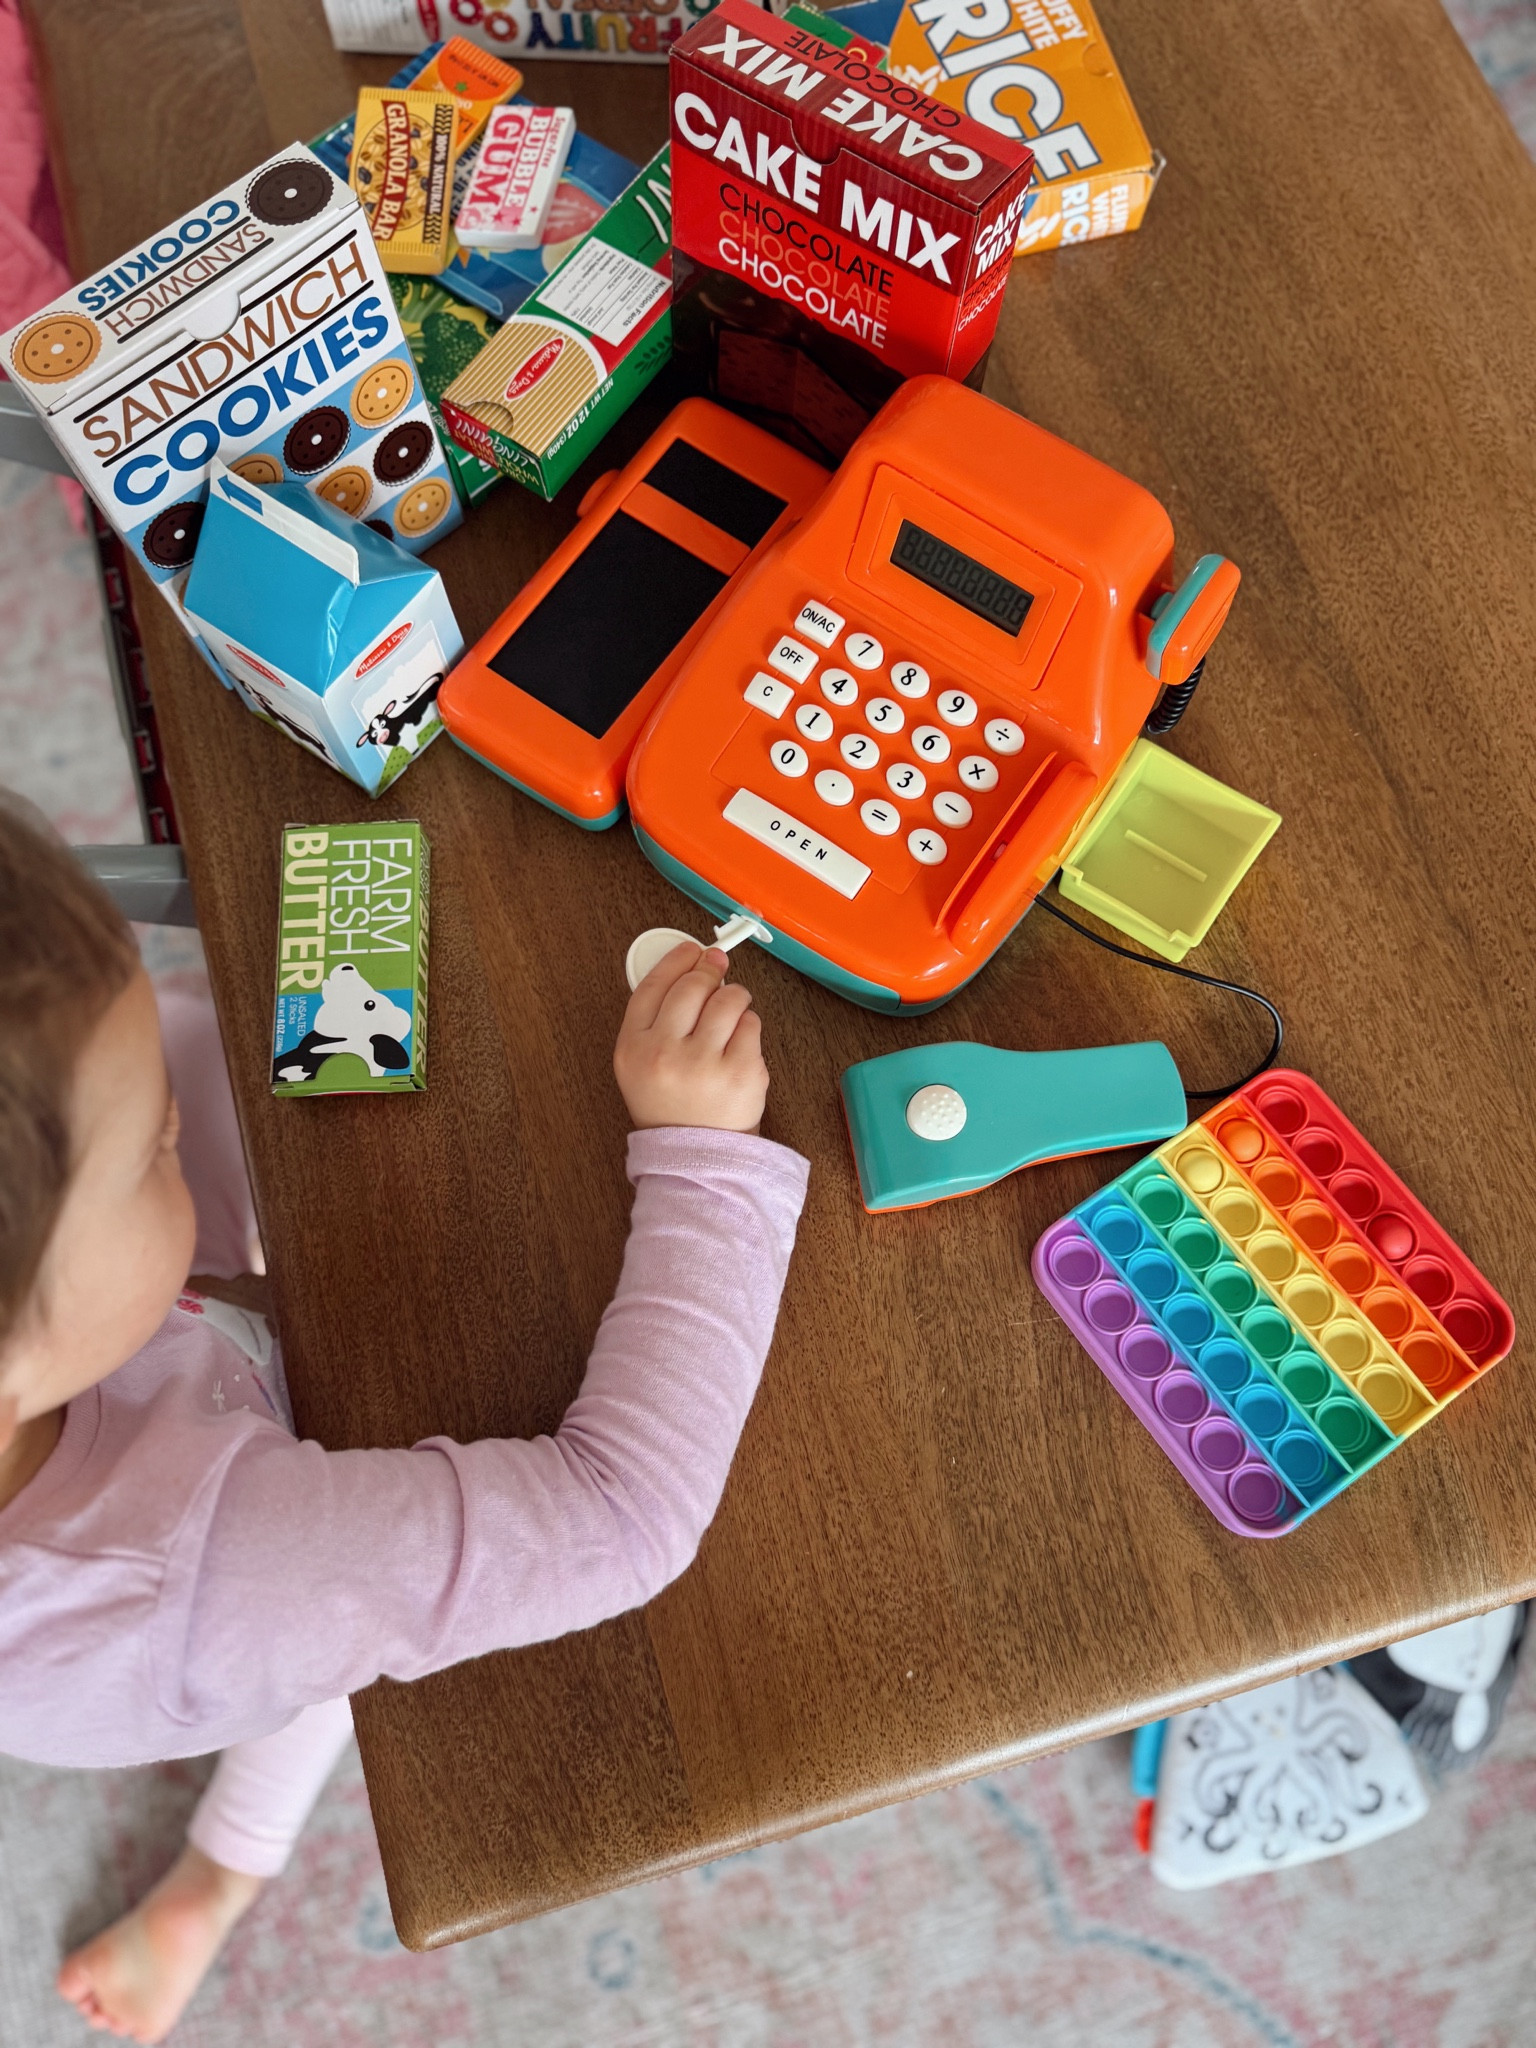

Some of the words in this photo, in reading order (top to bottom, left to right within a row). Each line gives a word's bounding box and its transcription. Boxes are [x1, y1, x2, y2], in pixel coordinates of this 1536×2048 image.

[526, 12, 683, 53] FRUITY
[698, 24, 827, 101] MIX
[783, 31, 961, 128] CHOCOLATE
[909, 0, 1103, 182] RICE
[385, 102, 408, 196] GRANOLA
[434, 134, 449, 166] 100%
[469, 114, 525, 207] GUM
[504, 115, 551, 207] BUBBLE
[820, 88, 983, 181] CAKE
[373, 201, 402, 240] BAR
[429, 164, 445, 214] NATURAL
[674, 92, 823, 213] CAKE
[840, 179, 962, 285] MIX
[975, 183, 1029, 255] CAKE
[77, 199, 240, 312] COOKIES
[719, 183, 894, 296] CHOCOLATE
[719, 210, 890, 322] CHOCOLATE
[975, 218, 1017, 280] MIX
[105, 222, 266, 336] SANDWICH
[622, 306, 643, 327] Facts
[637, 279, 666, 309] Nutrition
[718, 238, 887, 349] CHOCOLATE
[82, 241, 368, 458] SANDWICH
[601, 377, 614, 398] NET
[113, 296, 389, 506] COOKIES
[590, 393, 602, 410] WT
[780, 646, 804, 665] OFF
[802, 608, 836, 633] ON/AC
[763, 686, 774, 697] C
[831, 678, 848, 695] 4
[874, 704, 892, 722] 5
[922, 734, 940, 751] 6
[857, 640, 874, 657] 7
[900, 668, 917, 686] 8
[947, 696, 965, 713] 9
[781, 748, 796, 765] 0
[805, 712, 821, 729] 1
[849, 740, 867, 759] 2
[897, 771, 914, 788] 3
[770, 820, 827, 860] OPEN
[280, 832, 329, 990] BUTTER
[329, 839, 371, 955] FRESH
[370, 838, 412, 953] FARM
[297, 996, 307, 1036] UNSALTED
[416, 898, 430, 1074] BUTTER
